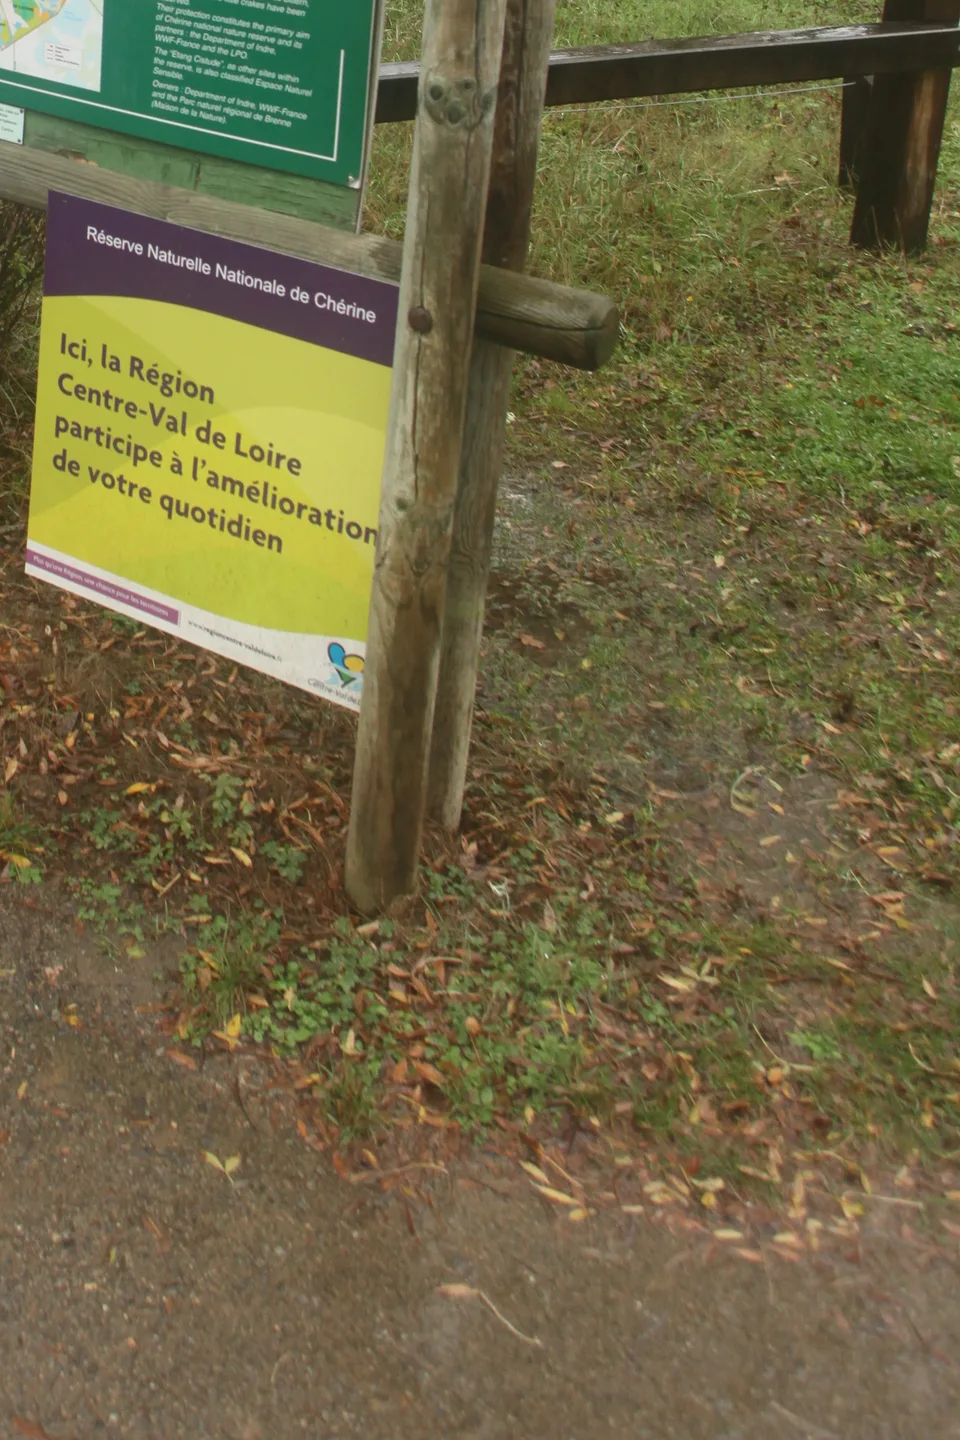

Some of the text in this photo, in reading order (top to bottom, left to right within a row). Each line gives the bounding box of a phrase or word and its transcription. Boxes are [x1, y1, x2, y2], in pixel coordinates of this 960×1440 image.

[87, 226, 376, 323] Réserve Naturelle Nationale de Chérine
[60, 332, 215, 404] Ici, la Région
[55, 418, 162, 471] participe
[170, 454, 182, 478] à
[58, 373, 302, 476] Centre-Val de Loire
[52, 451, 283, 553] de votre quotidien
